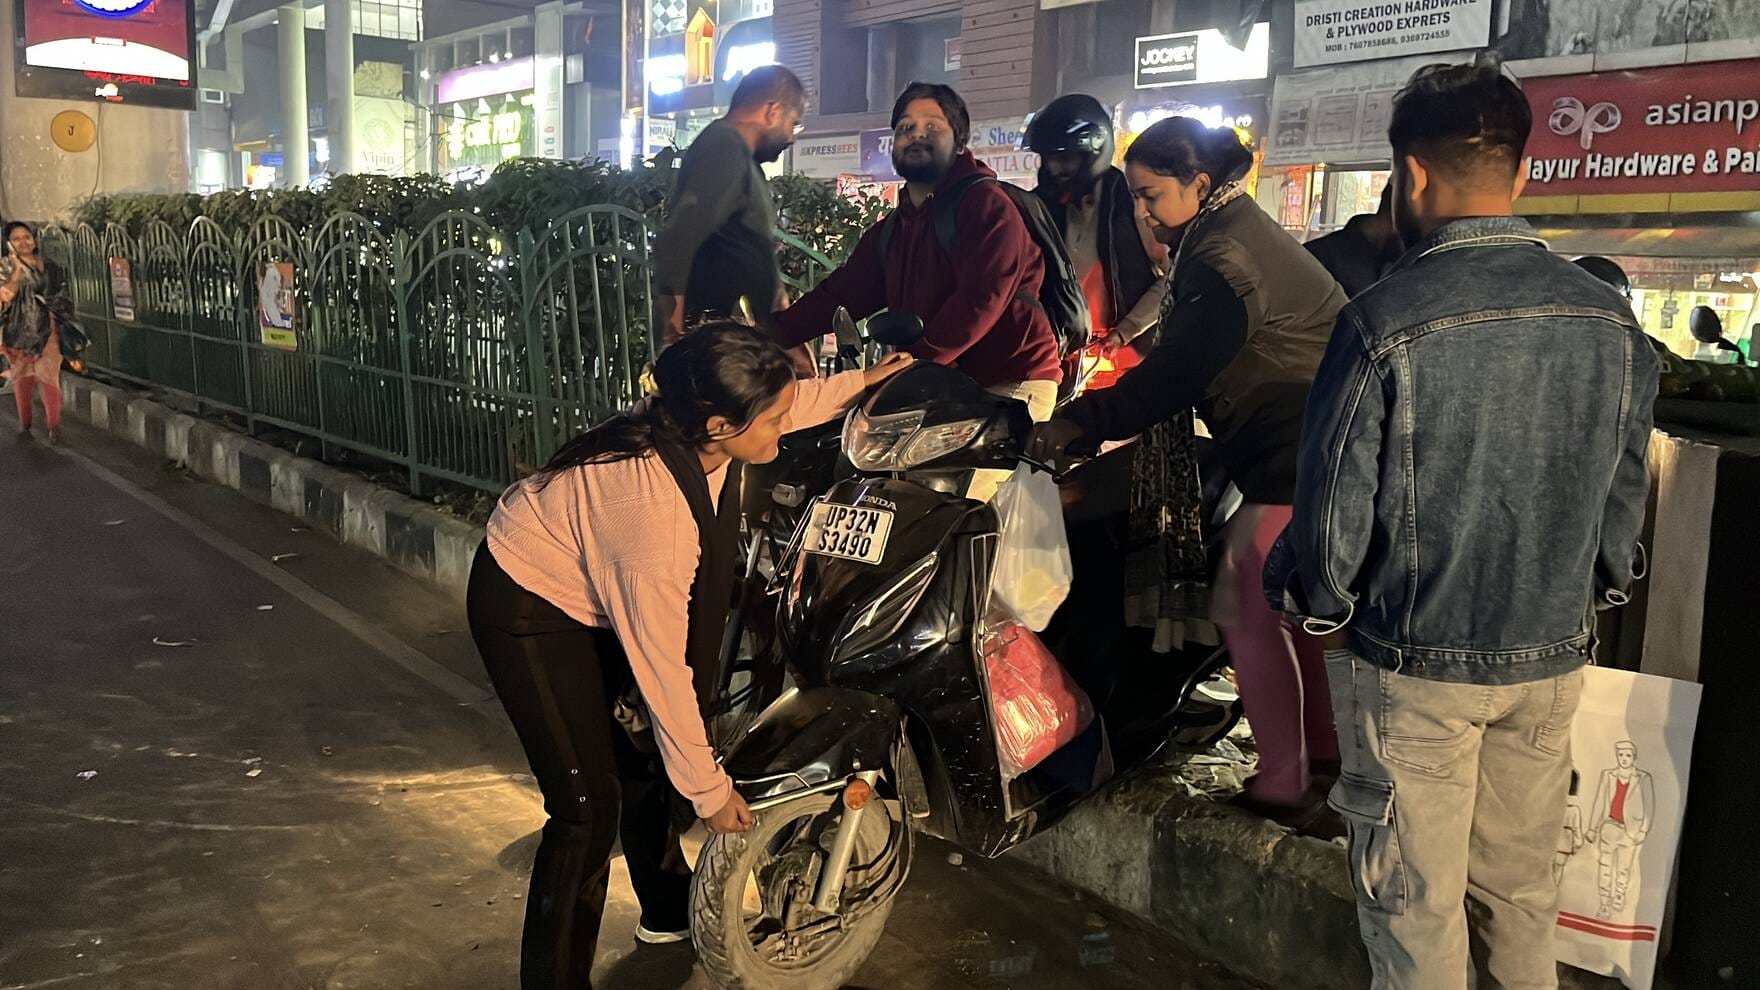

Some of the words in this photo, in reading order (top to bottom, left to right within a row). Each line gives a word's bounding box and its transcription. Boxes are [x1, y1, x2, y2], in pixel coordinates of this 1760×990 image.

[1306, 11, 1341, 27] DRISTI
[1344, 3, 1401, 22] CREATION
[1405, 0, 1476, 13] HARDWA
[1326, 27, 1334, 39] &
[1338, 21, 1393, 38] PLYWOOD
[1396, 11, 1450, 30] EXPRETS
[1140, 45, 1195, 66] JOCKEY
[1325, 43, 1342, 52] MOB
[1585, 152, 1696, 179] Hardware
[1702, 149, 1718, 174] &
[826, 506, 880, 535] UP32N
[819, 530, 872, 558] S3490
